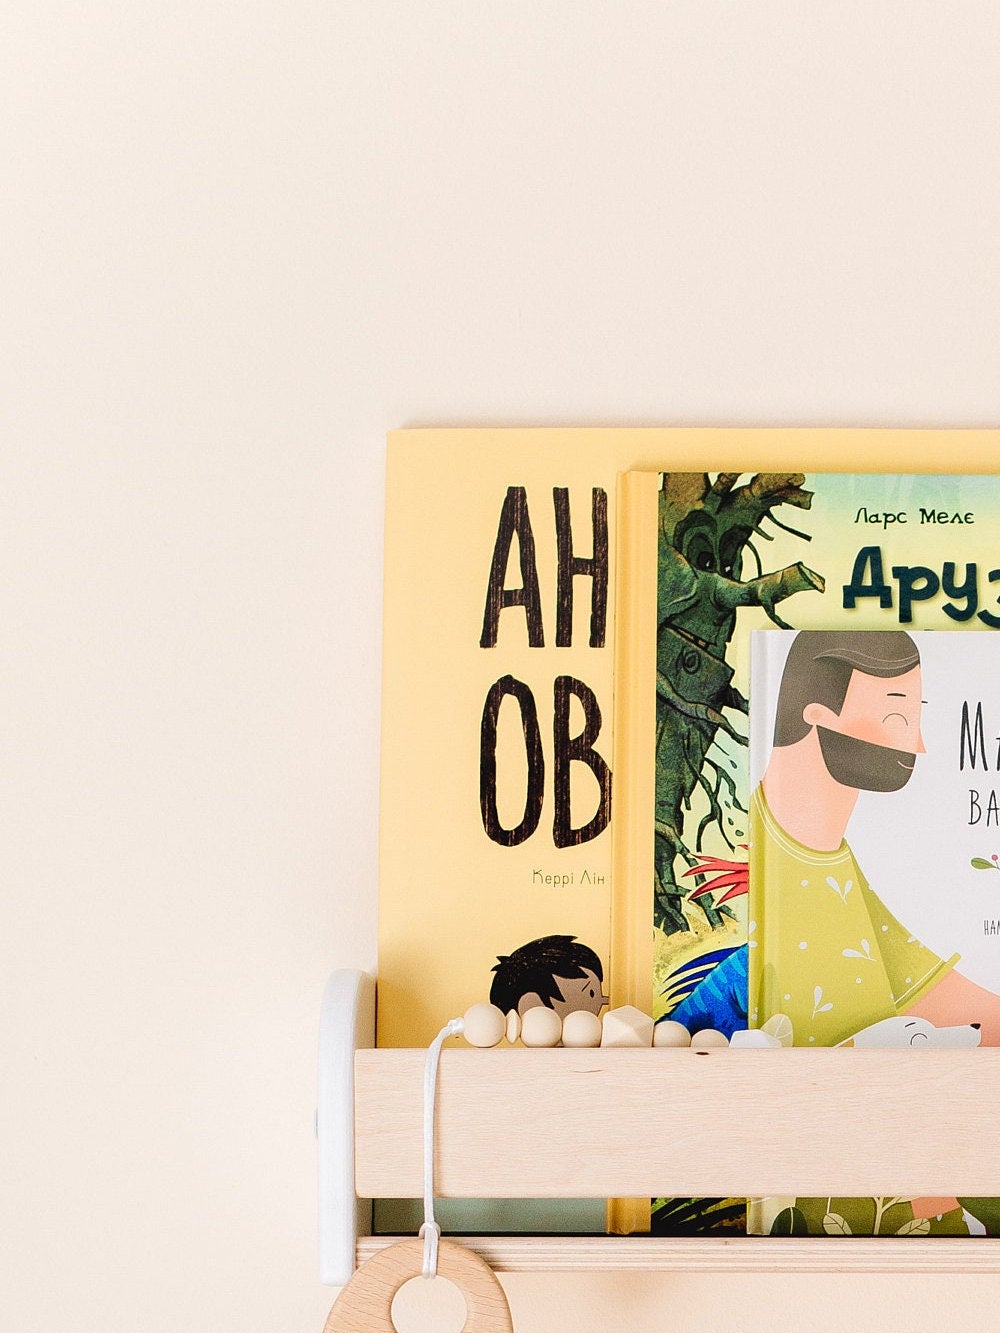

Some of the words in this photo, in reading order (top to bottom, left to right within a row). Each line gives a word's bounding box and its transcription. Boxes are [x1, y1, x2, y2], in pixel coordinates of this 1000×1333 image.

[854, 507, 907, 529] Ларс
[919, 508, 975, 524] Мелє
[479, 486, 608, 648] АН
[532, 868, 574, 888] Керрі
